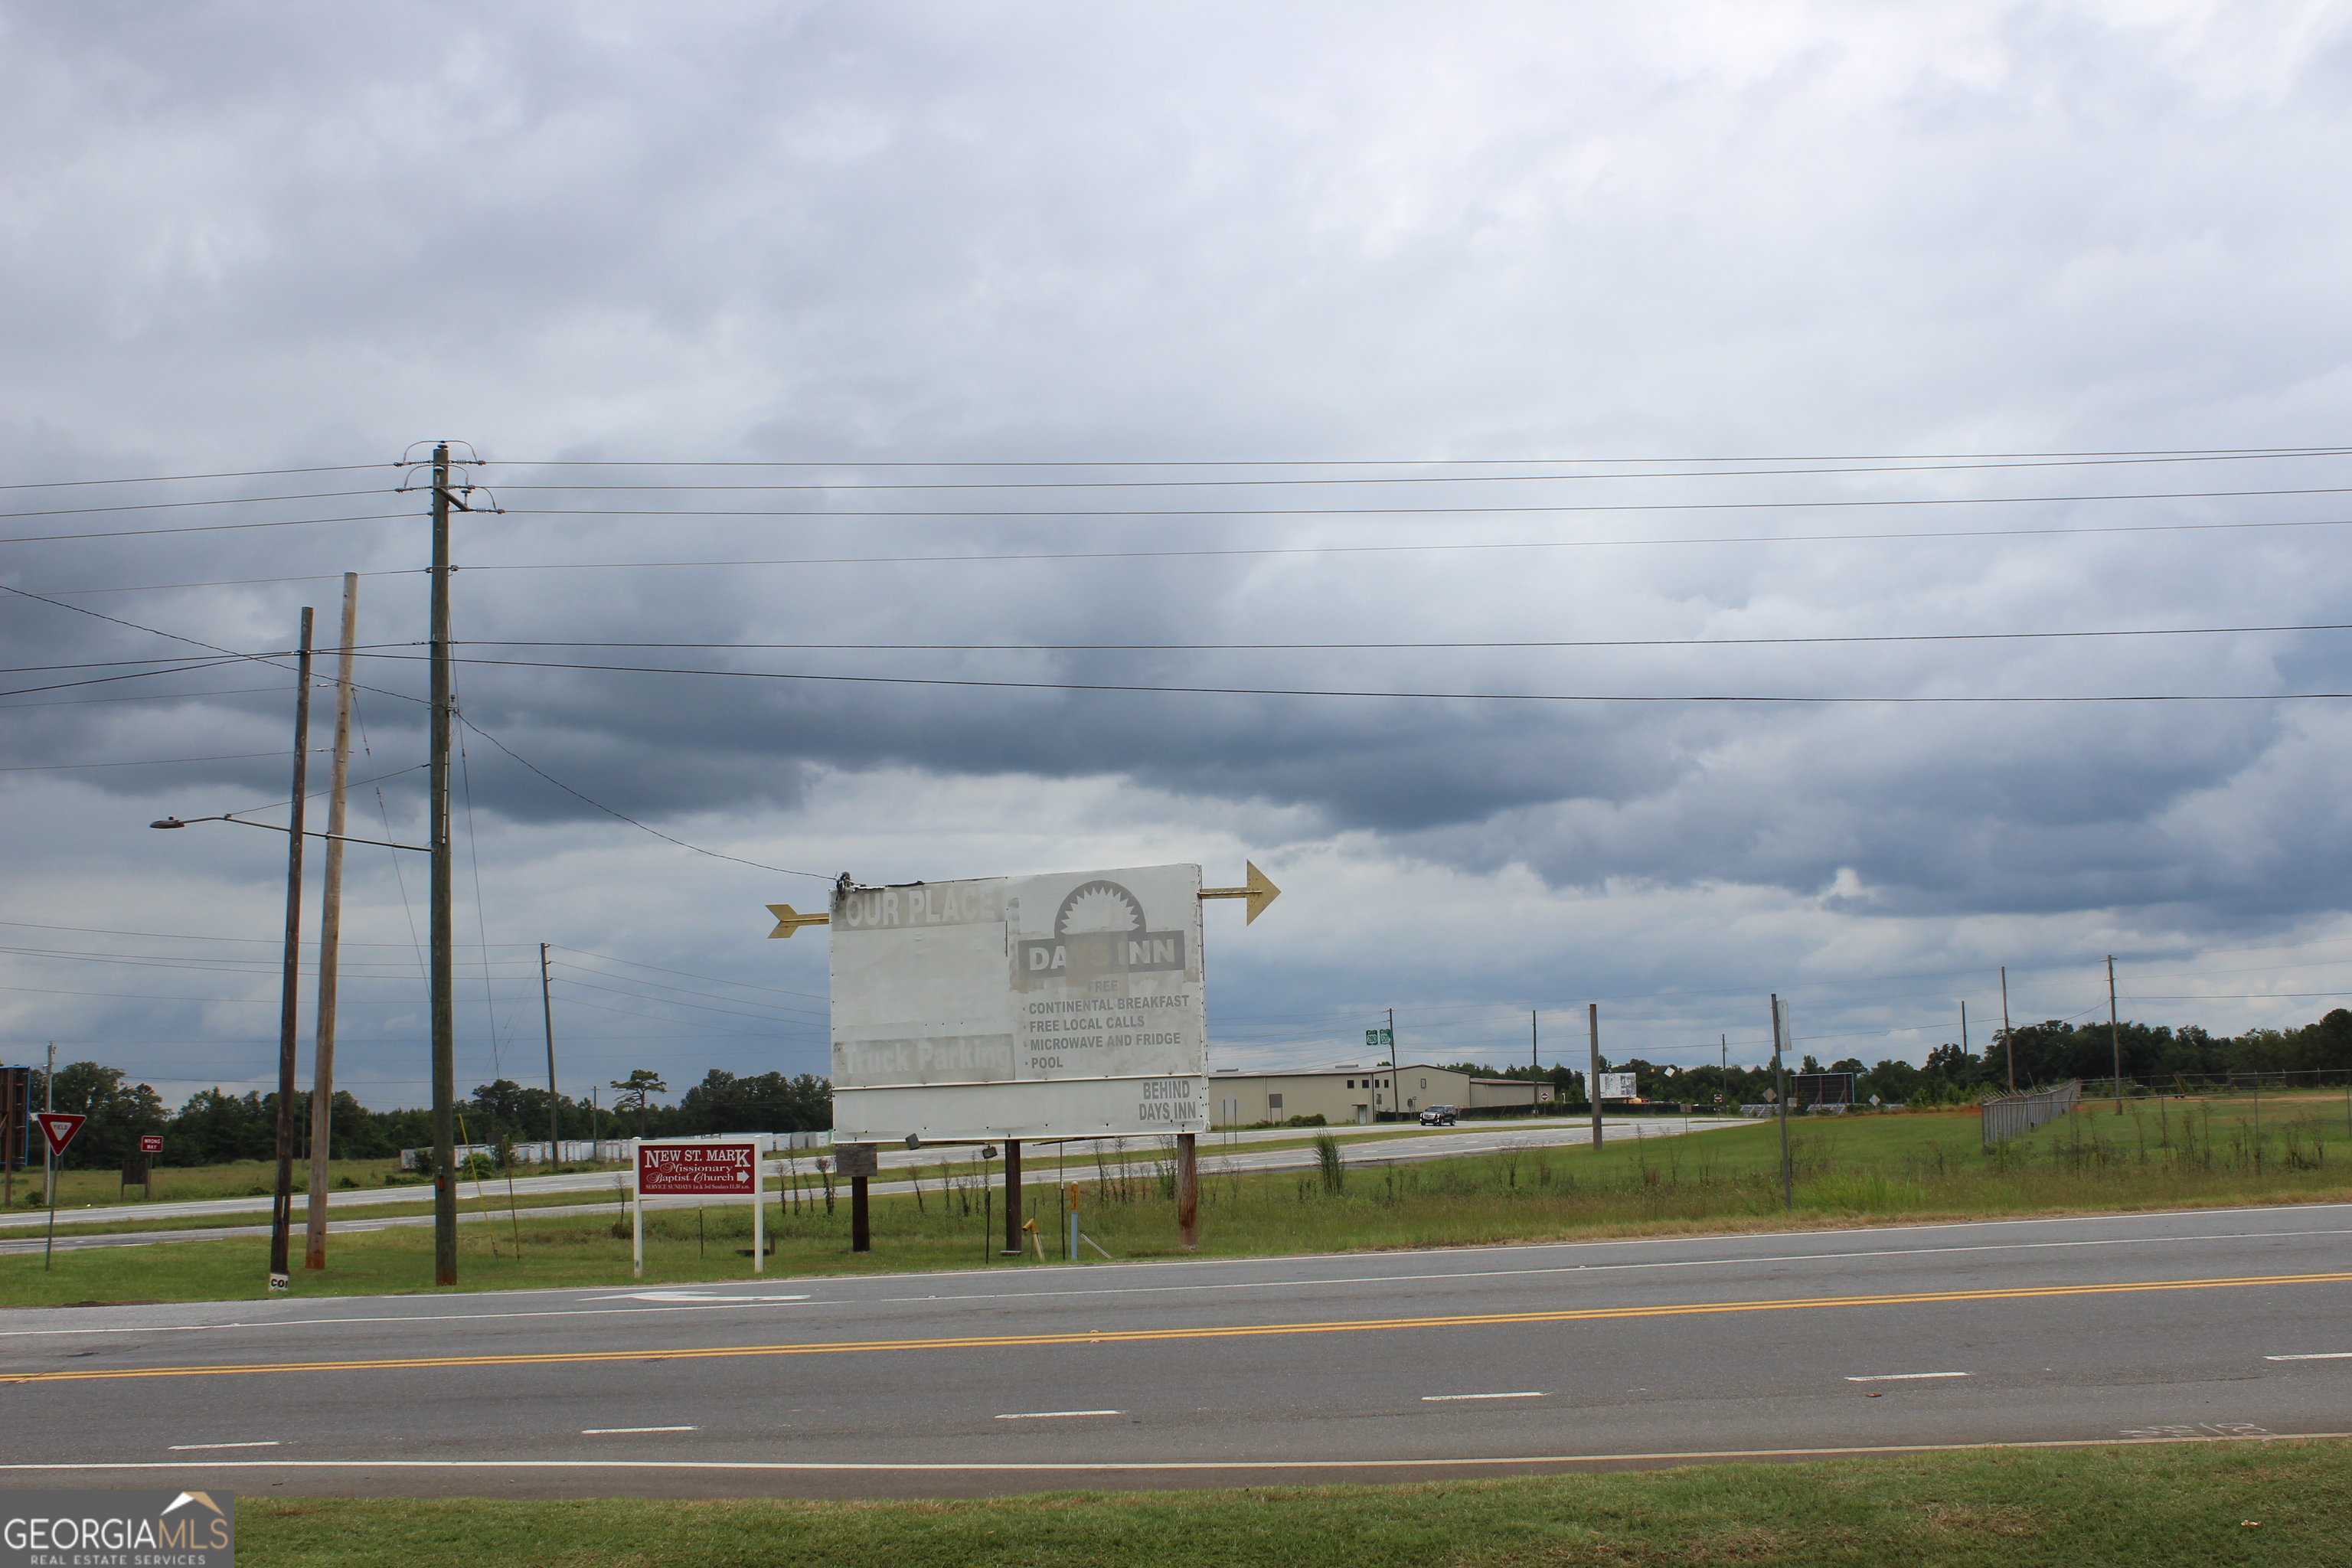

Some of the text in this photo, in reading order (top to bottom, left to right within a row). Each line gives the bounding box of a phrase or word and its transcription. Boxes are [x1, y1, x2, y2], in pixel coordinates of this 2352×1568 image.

[846, 887, 995, 926] OUR PLACE
[1117, 939, 1175, 965] INN
[1088, 979, 1119, 993] FREE
[1029, 995, 1190, 1014] CONTINENTAL BREAKFAST
[1030, 1015, 1145, 1033] FREE LOCAL CALLS
[1030, 1032, 1181, 1051] MICROWAVE AND FRIDGE
[843, 1038, 1011, 1074] Truck Parking
[1031, 1057, 1063, 1069] POOL
[1143, 1080, 1190, 1099] BEHIND
[1138, 1102, 1196, 1120] DAYS INN
[645, 1149, 750, 1168] NEW ST. MARK
[659, 1161, 733, 1173] Missionary
[646, 1171, 734, 1183] Baptist Church
